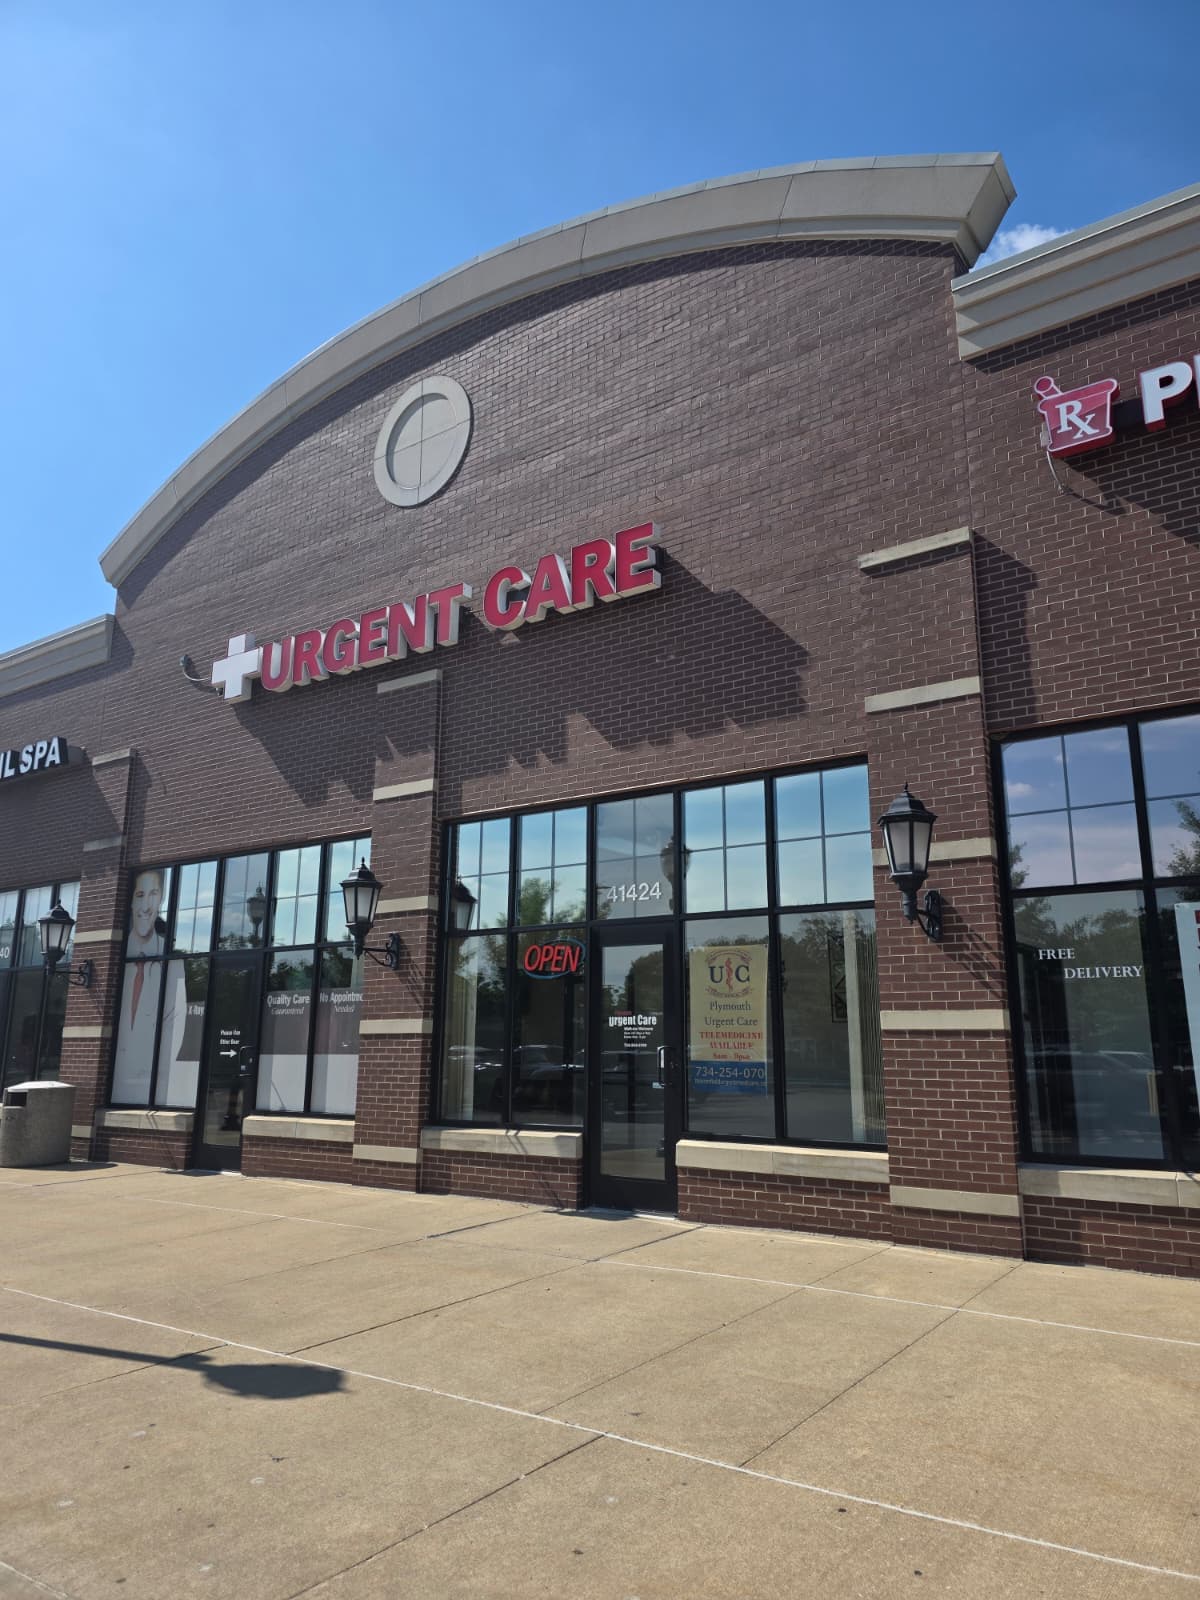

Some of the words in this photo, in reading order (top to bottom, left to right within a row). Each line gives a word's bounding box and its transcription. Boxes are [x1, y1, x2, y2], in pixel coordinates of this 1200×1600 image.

[260, 583, 469, 691] URGENT
[482, 521, 661, 629] CARE
[20, 736, 61, 773] SPA
[607, 881, 662, 902] 41424
[524, 944, 580, 972] OPEN
[1039, 948, 1076, 960] FREE
[1064, 965, 1143, 979] DELIVERY
[266, 993, 293, 1009] Quality
[293, 993, 310, 1005] Care
[710, 1000, 752, 1013] Plymouth
[637, 1014, 657, 1026] Care
[704, 1016, 734, 1028] Urgent
[736, 1016, 759, 1026] Care
